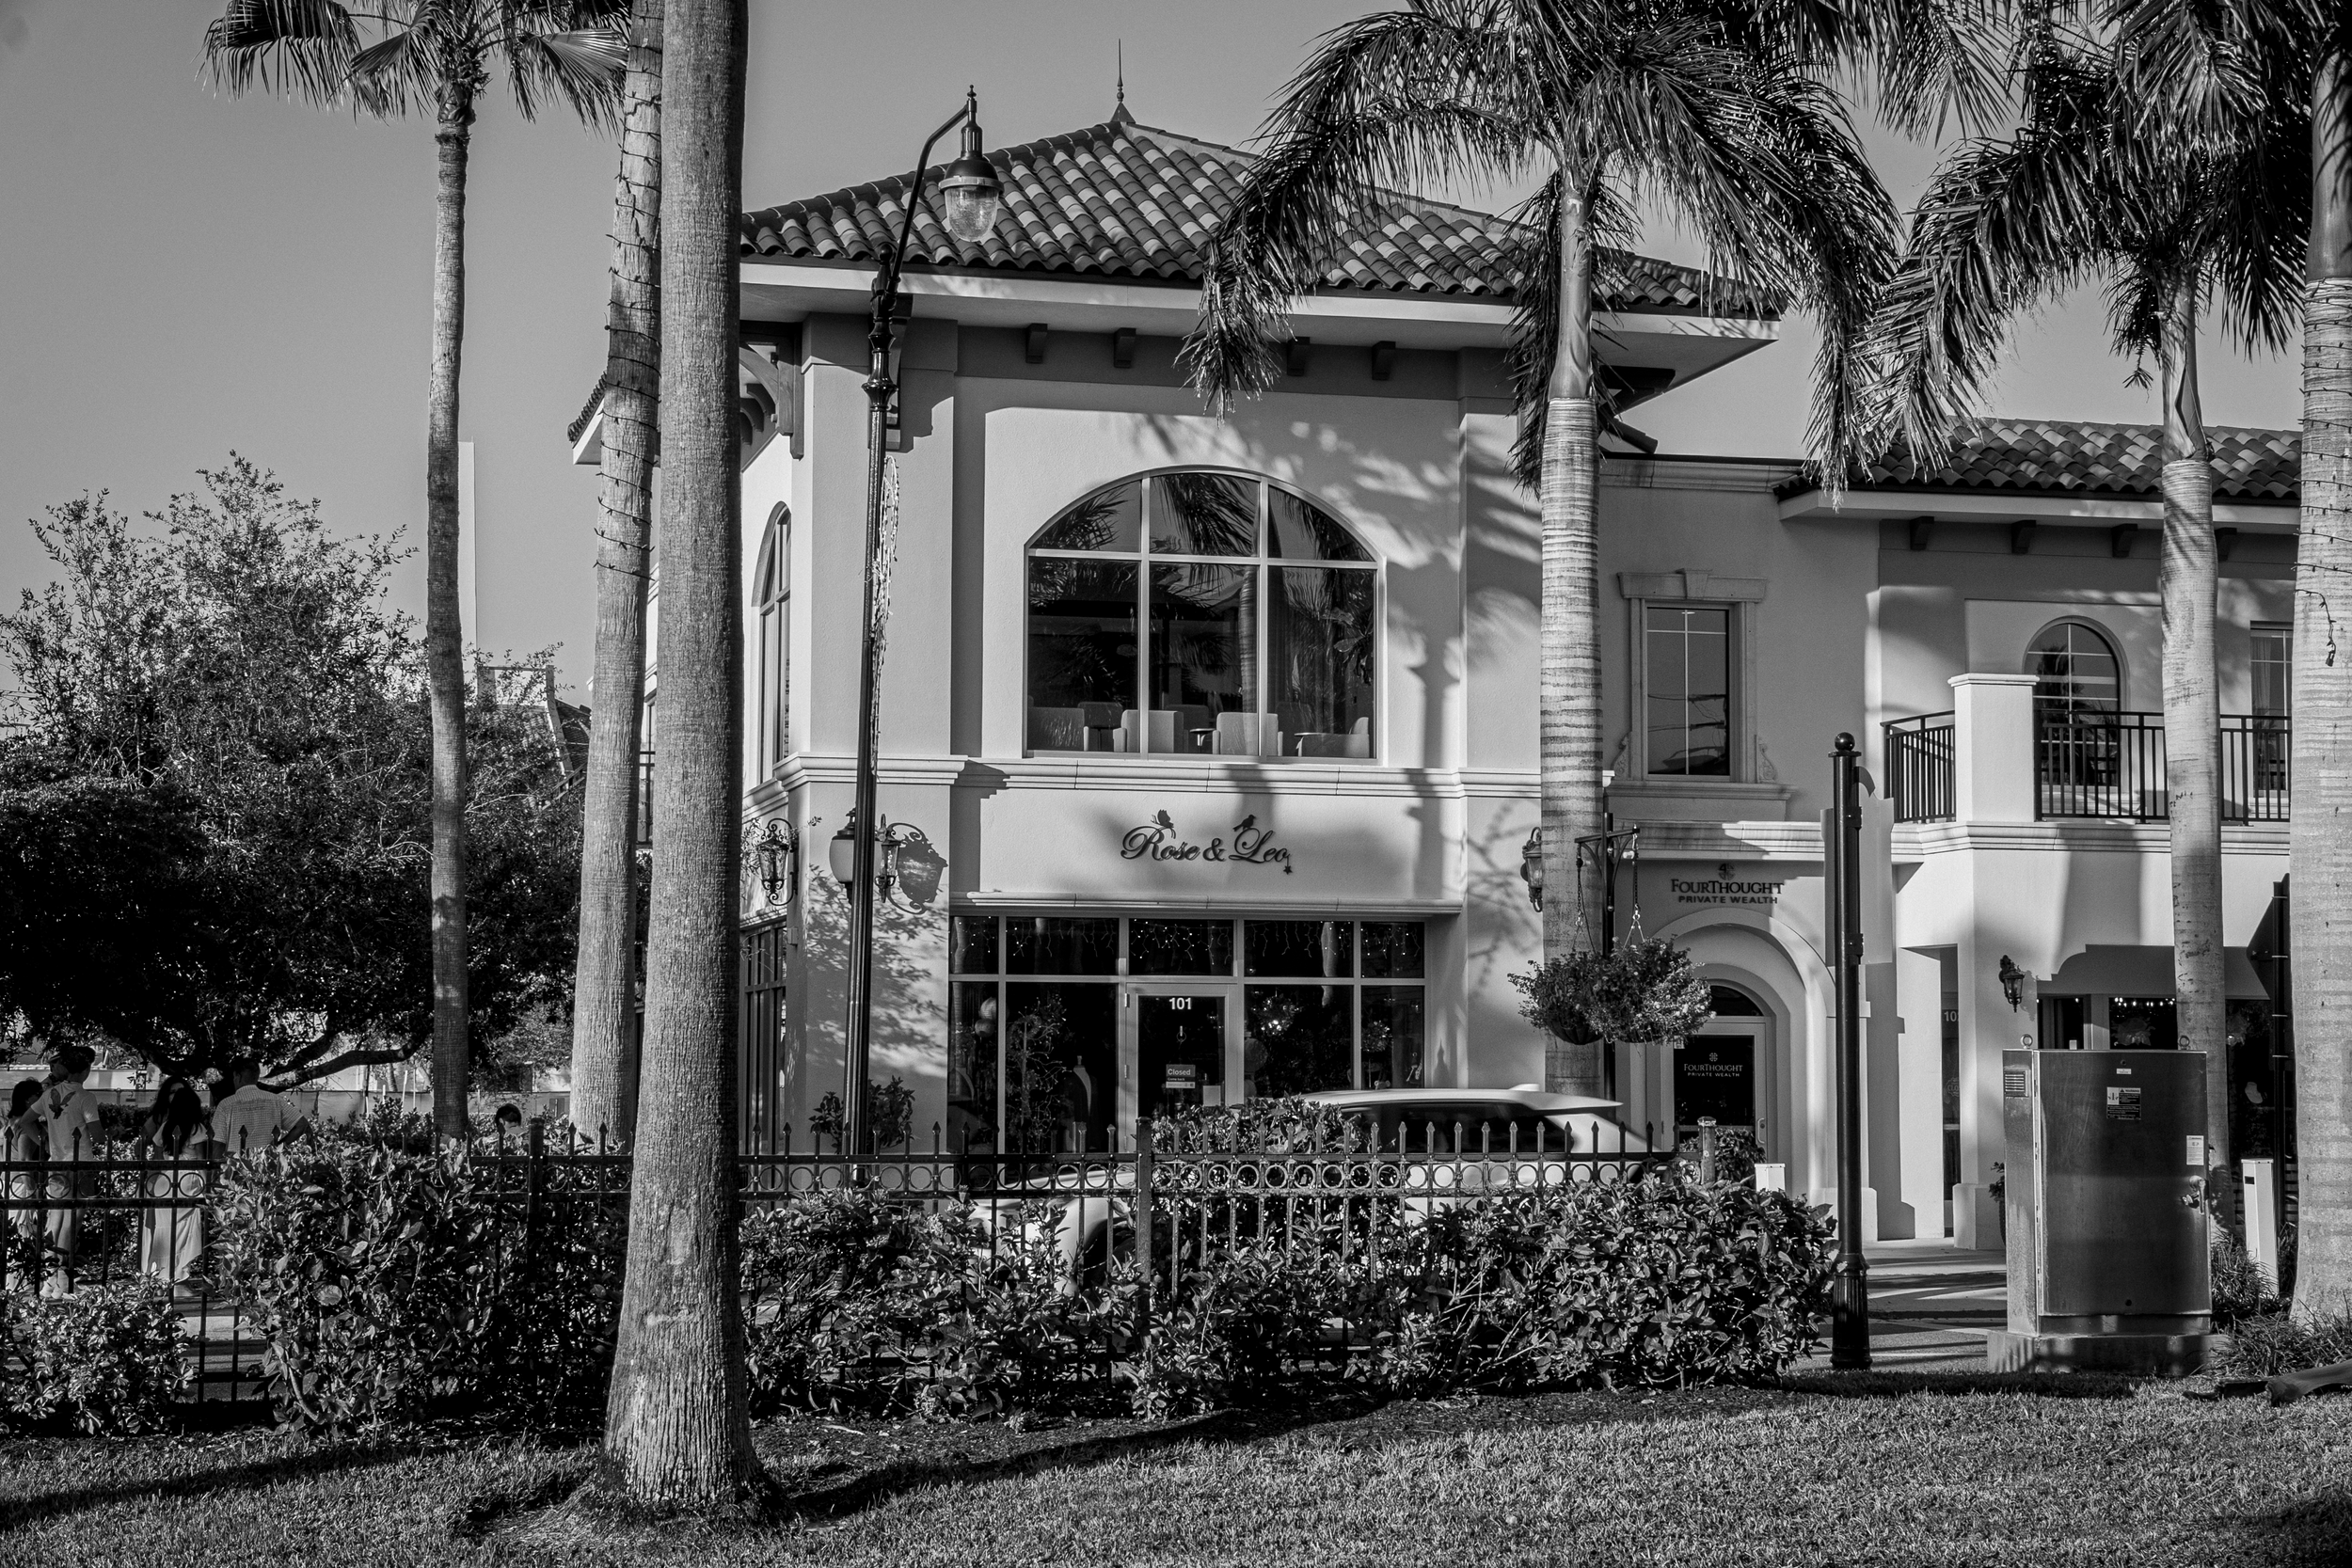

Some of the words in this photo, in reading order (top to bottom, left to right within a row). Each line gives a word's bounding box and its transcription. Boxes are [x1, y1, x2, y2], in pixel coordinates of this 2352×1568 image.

[1120, 826, 1200, 862] Rose
[1202, 837, 1226, 862] &
[1229, 827, 1291, 864] Leo
[1678, 895, 1726, 904] PRIVATE
[1730, 895, 1778, 904] WEALTH
[1168, 997, 1192, 1010] 101
[1944, 1010, 1959, 1022] 10
[1168, 1068, 1191, 1076] Closed
